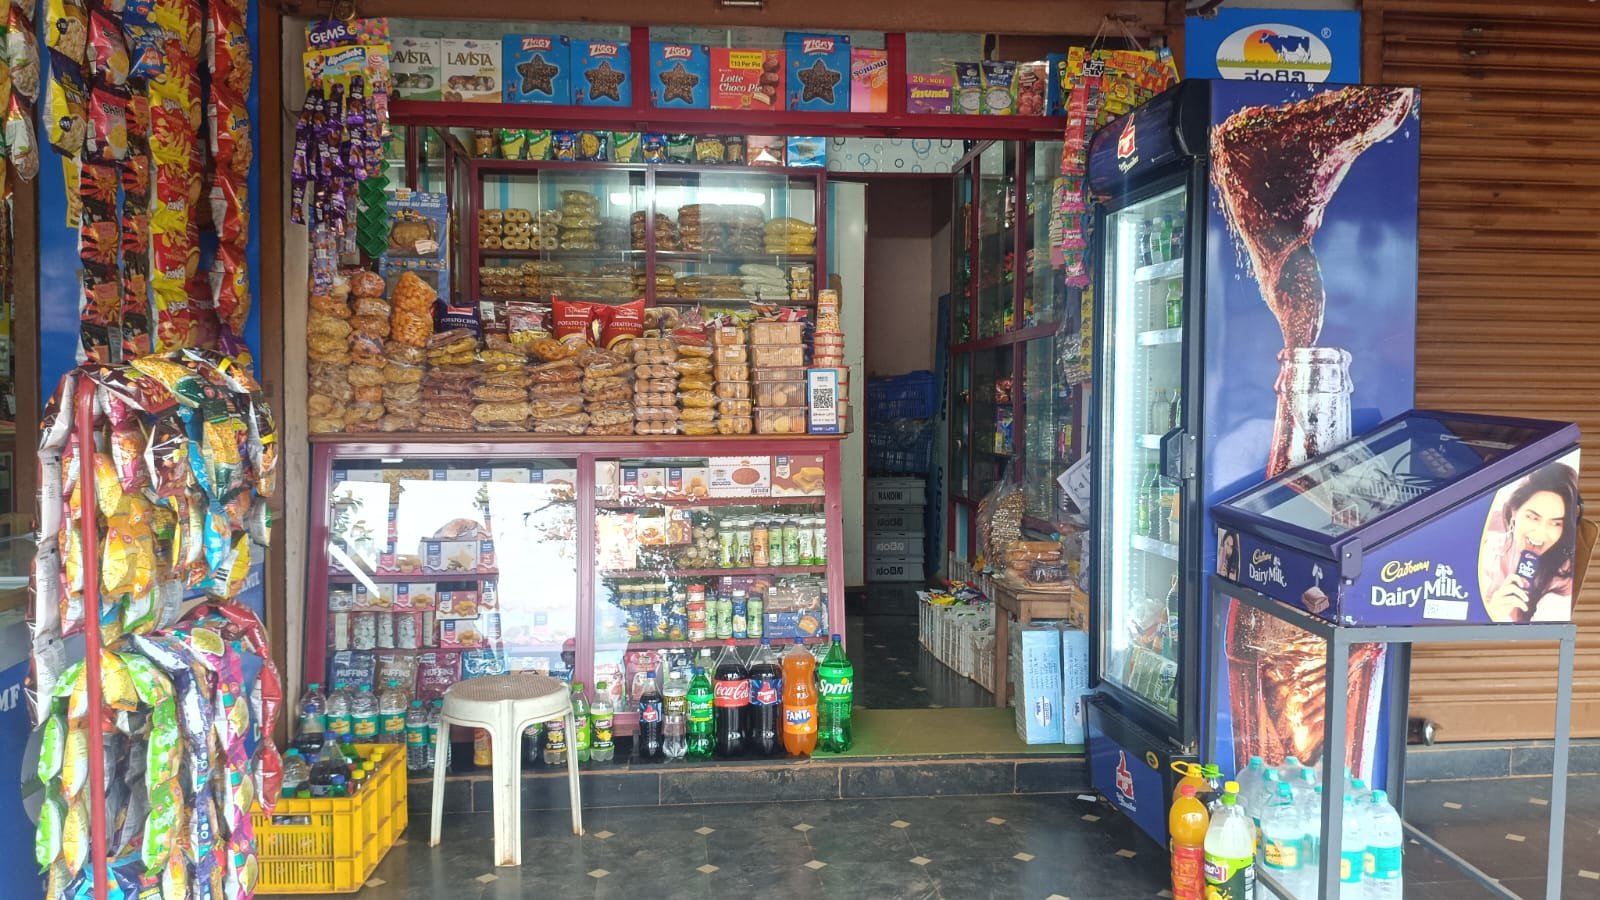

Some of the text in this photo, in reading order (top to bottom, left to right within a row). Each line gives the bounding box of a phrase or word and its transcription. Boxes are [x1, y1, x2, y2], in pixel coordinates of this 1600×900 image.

[310, 25, 346, 43] GEMS
[522, 38, 551, 49] ZIGGY
[589, 43, 617, 56] ZIGGY
[803, 38, 834, 52] ZIGGY
[664, 45, 692, 58] ZIGGY
[447, 51, 493, 66] LAVISTA
[720, 74, 743, 83] Lotte
[719, 82, 763, 92] Choco Pie
[878, 491, 903, 500] NANDINI
[1249, 563, 1288, 588] Dairy Milk
[1380, 559, 1430, 583] Cadbury
[1371, 577, 1469, 608] Dairy Milk
[336, 669, 369, 677] MUFFINS
[381, 669, 411, 677] MUFFINS
[819, 679, 854, 697] Sprite
[786, 709, 811, 721] FANTA
